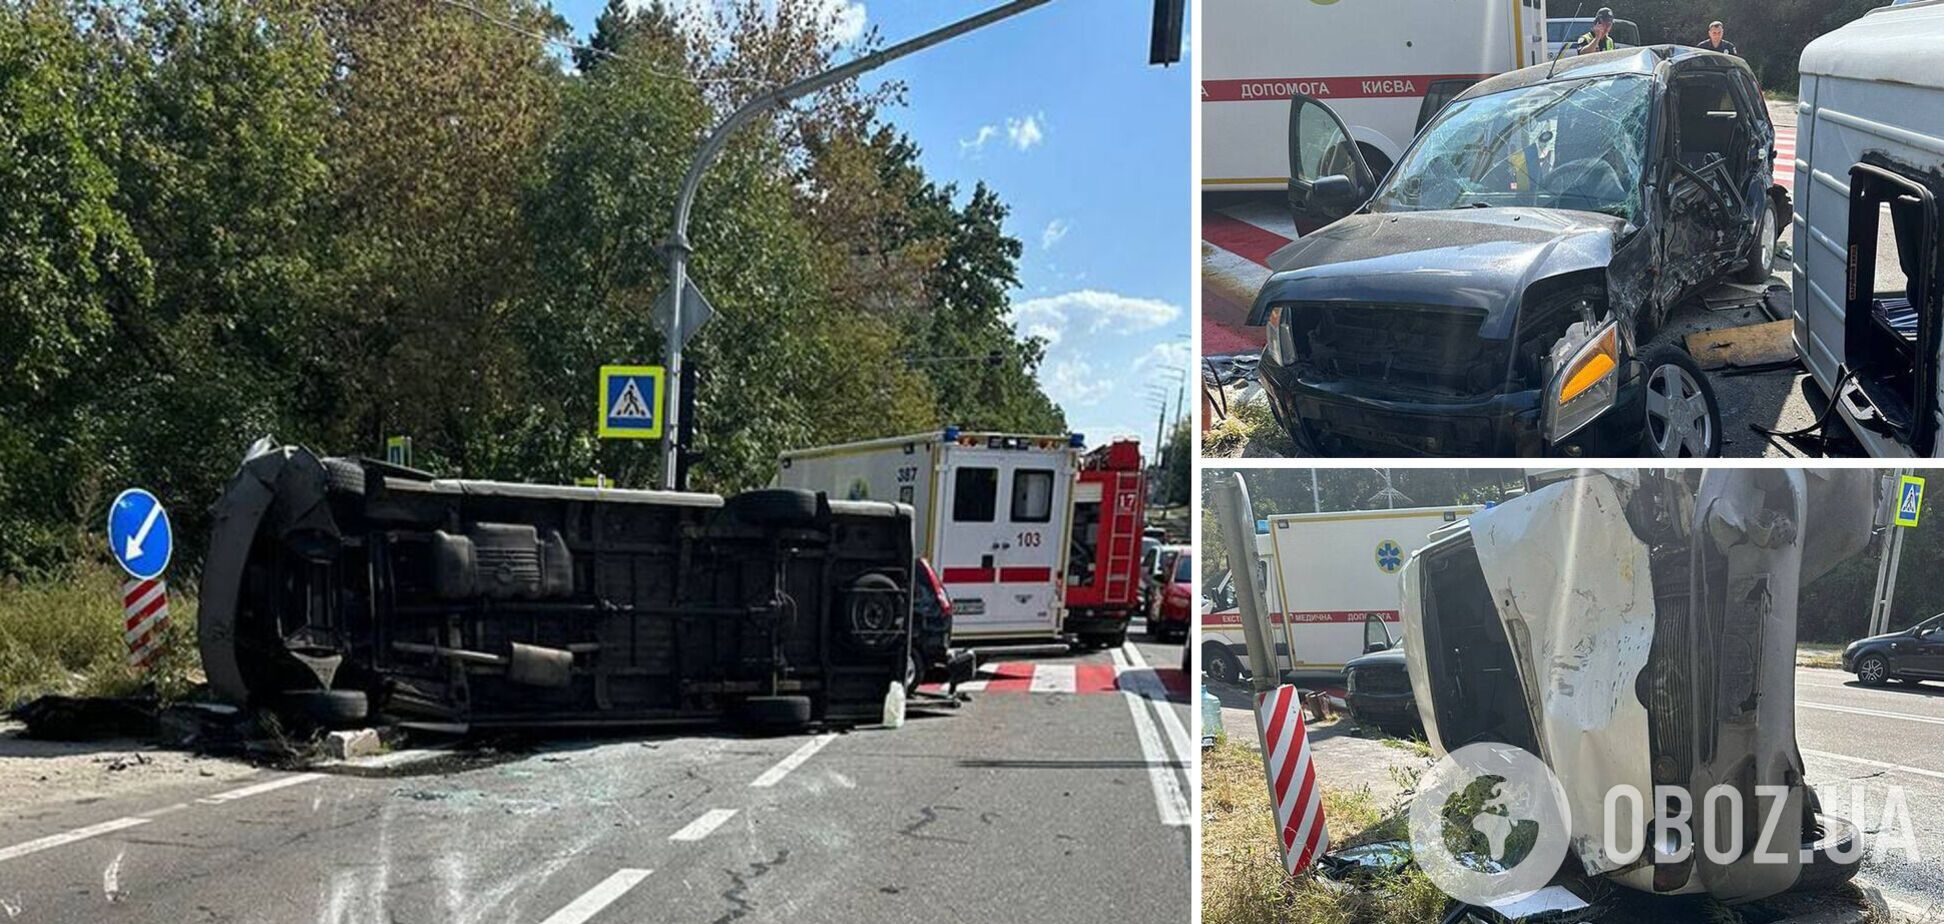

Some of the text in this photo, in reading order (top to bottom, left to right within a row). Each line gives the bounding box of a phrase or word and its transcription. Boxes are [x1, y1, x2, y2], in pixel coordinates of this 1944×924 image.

[1241, 82, 1330, 99] ДОПОМОГА
[1361, 80, 1415, 94] КИЄВА
[897, 466, 918, 482] 387
[1119, 494, 1136, 509] 17
[1017, 532, 1041, 547] 103
[1295, 612, 1332, 622] МЕДИЧНА
